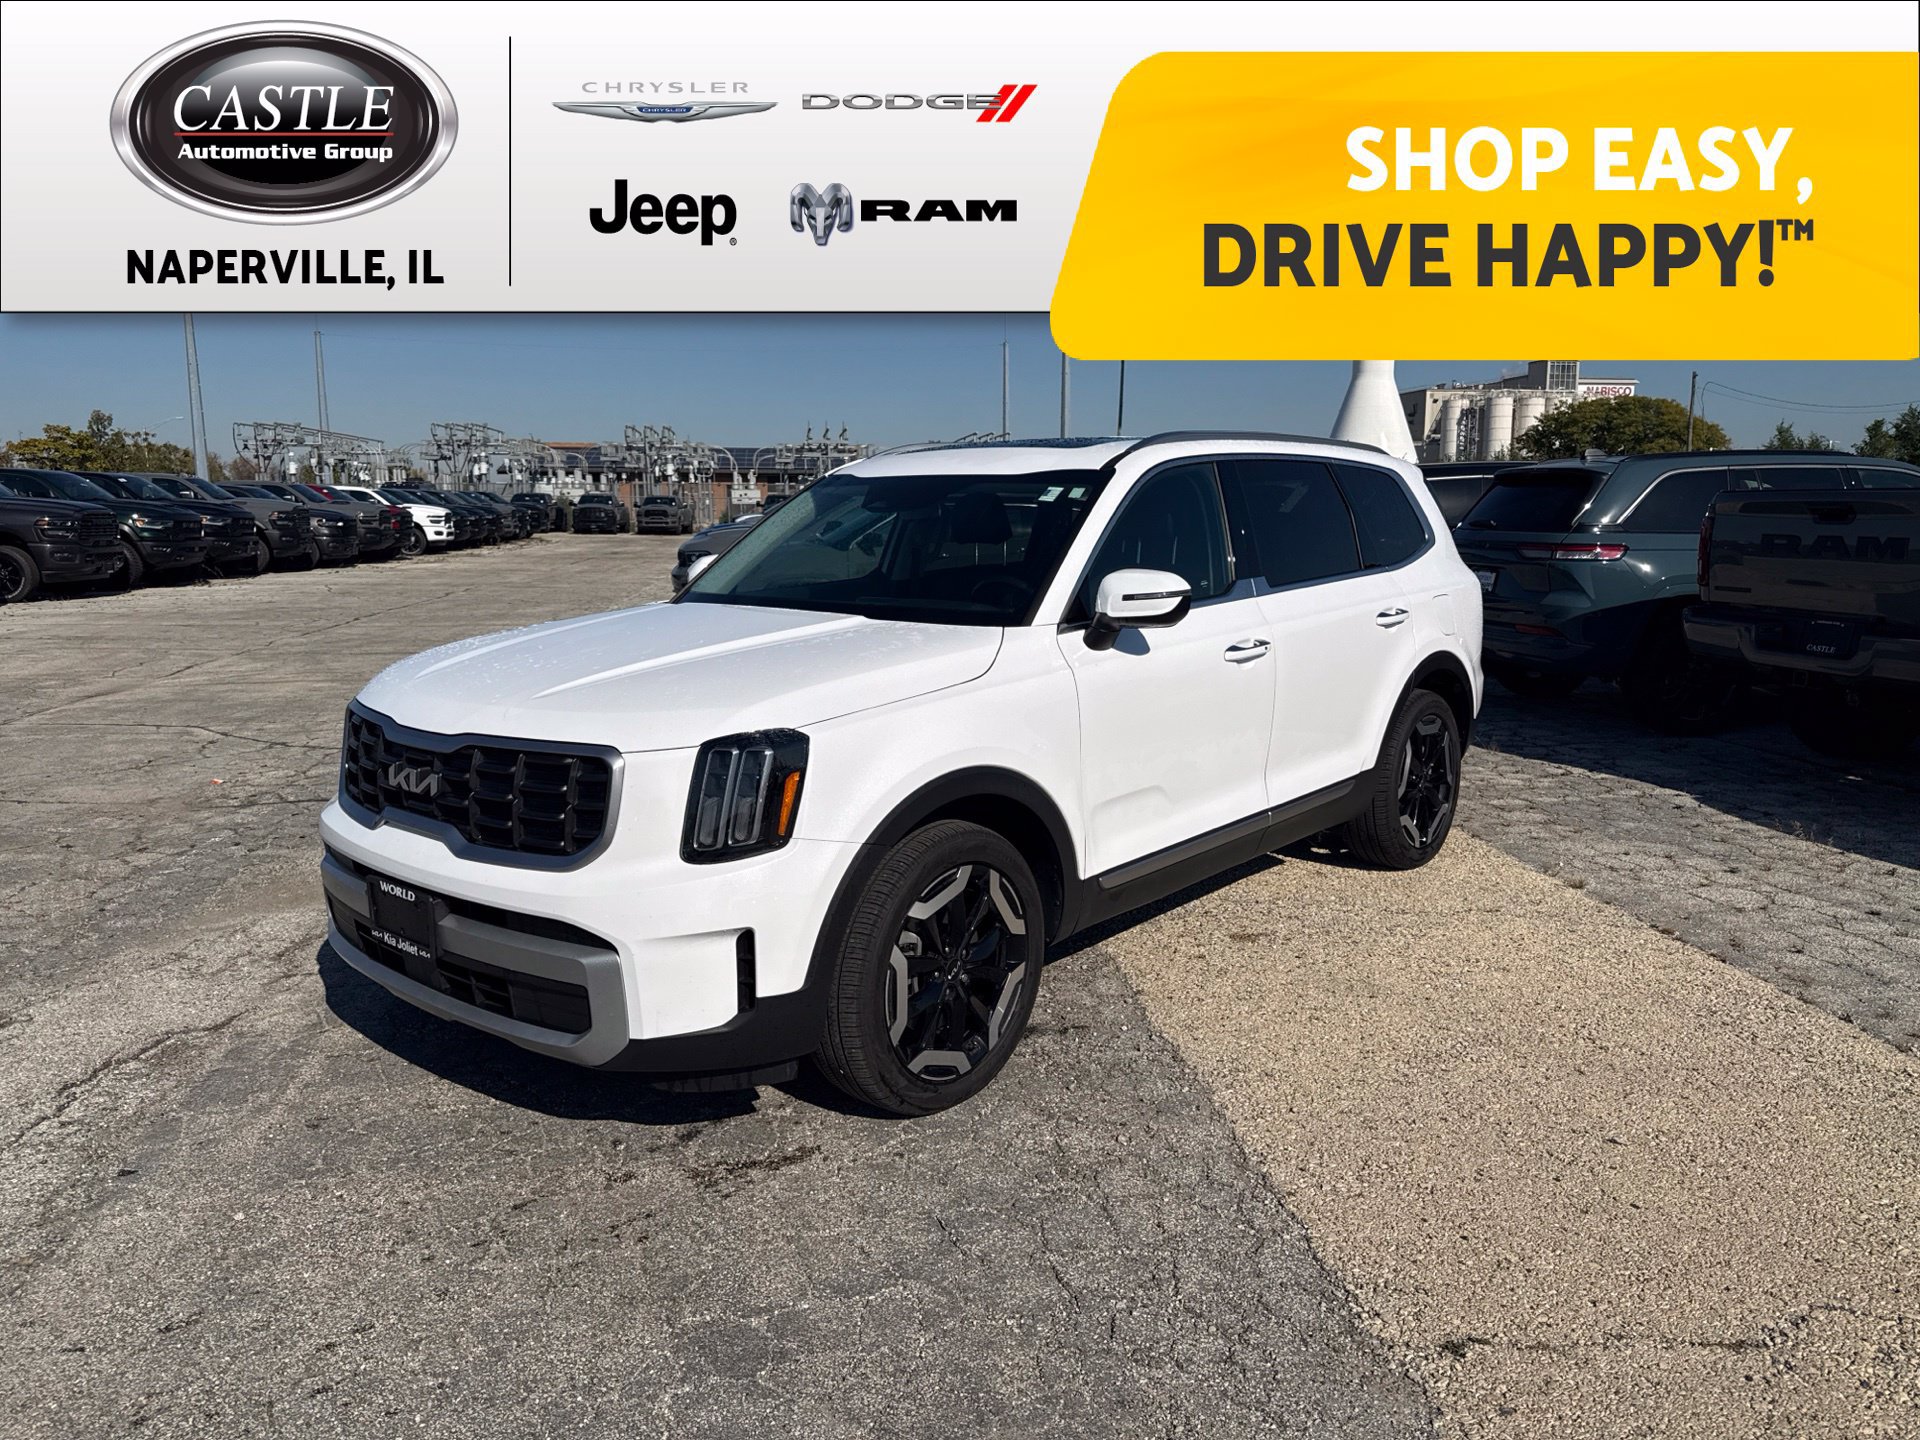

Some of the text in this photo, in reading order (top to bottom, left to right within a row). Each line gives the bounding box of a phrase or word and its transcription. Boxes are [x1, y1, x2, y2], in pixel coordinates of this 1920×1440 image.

[1586, 386, 1632, 397] NABISCO
[1761, 533, 1911, 560] RAM
[388, 763, 441, 797] KIA
[379, 880, 416, 902] WORLD
[383, 931, 397, 947] Kia
[397, 938, 419, 956] Joliet
